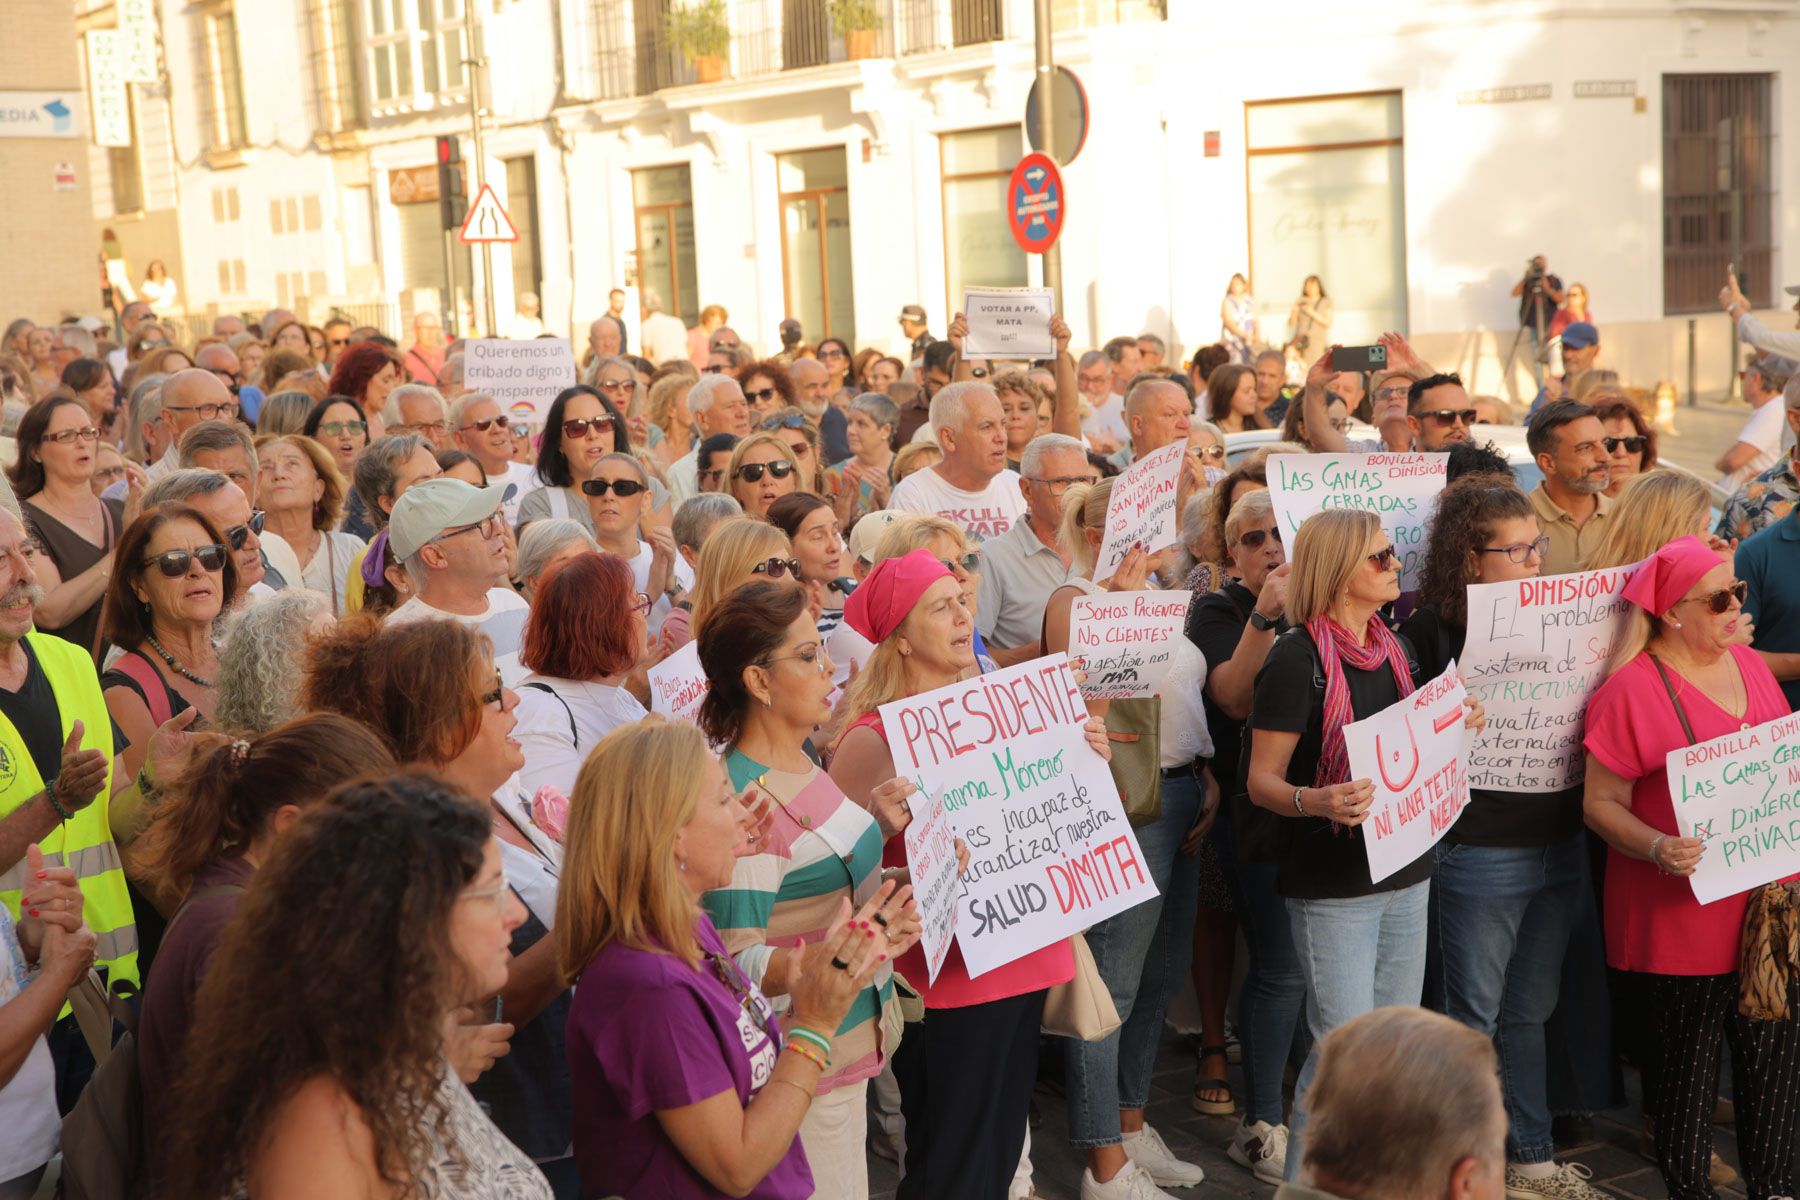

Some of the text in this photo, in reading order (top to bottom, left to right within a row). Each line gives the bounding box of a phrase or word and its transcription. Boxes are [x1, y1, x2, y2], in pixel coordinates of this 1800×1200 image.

[474, 344, 566, 359] Queremos un
[468, 365, 572, 381] cribado digno y
[1280, 460, 1383, 492] LAS CAMAS
[937, 507, 1009, 522] SKULL
[1322, 493, 1418, 517] CERRADAS
[1520, 571, 1617, 608] DIMISIÓN
[1541, 585, 1632, 652] problema
[1100, 668, 1139, 684] MATA
[1467, 651, 1551, 680] sistema
[1557, 638, 1576, 674] de
[898, 663, 1088, 769] PRESIDENTE
[1547, 755, 1565, 769] en
[1685, 733, 1762, 768] BONILLA
[1682, 774, 1717, 804] LAS
[1722, 760, 1771, 786] CAMAS
[966, 825, 992, 849] es
[1001, 791, 1069, 840] incapaz
[1070, 773, 1092, 809] de
[1066, 804, 1117, 848] nuestra
[968, 882, 1048, 938] SALUD
[1045, 834, 1146, 915] DIMITA
